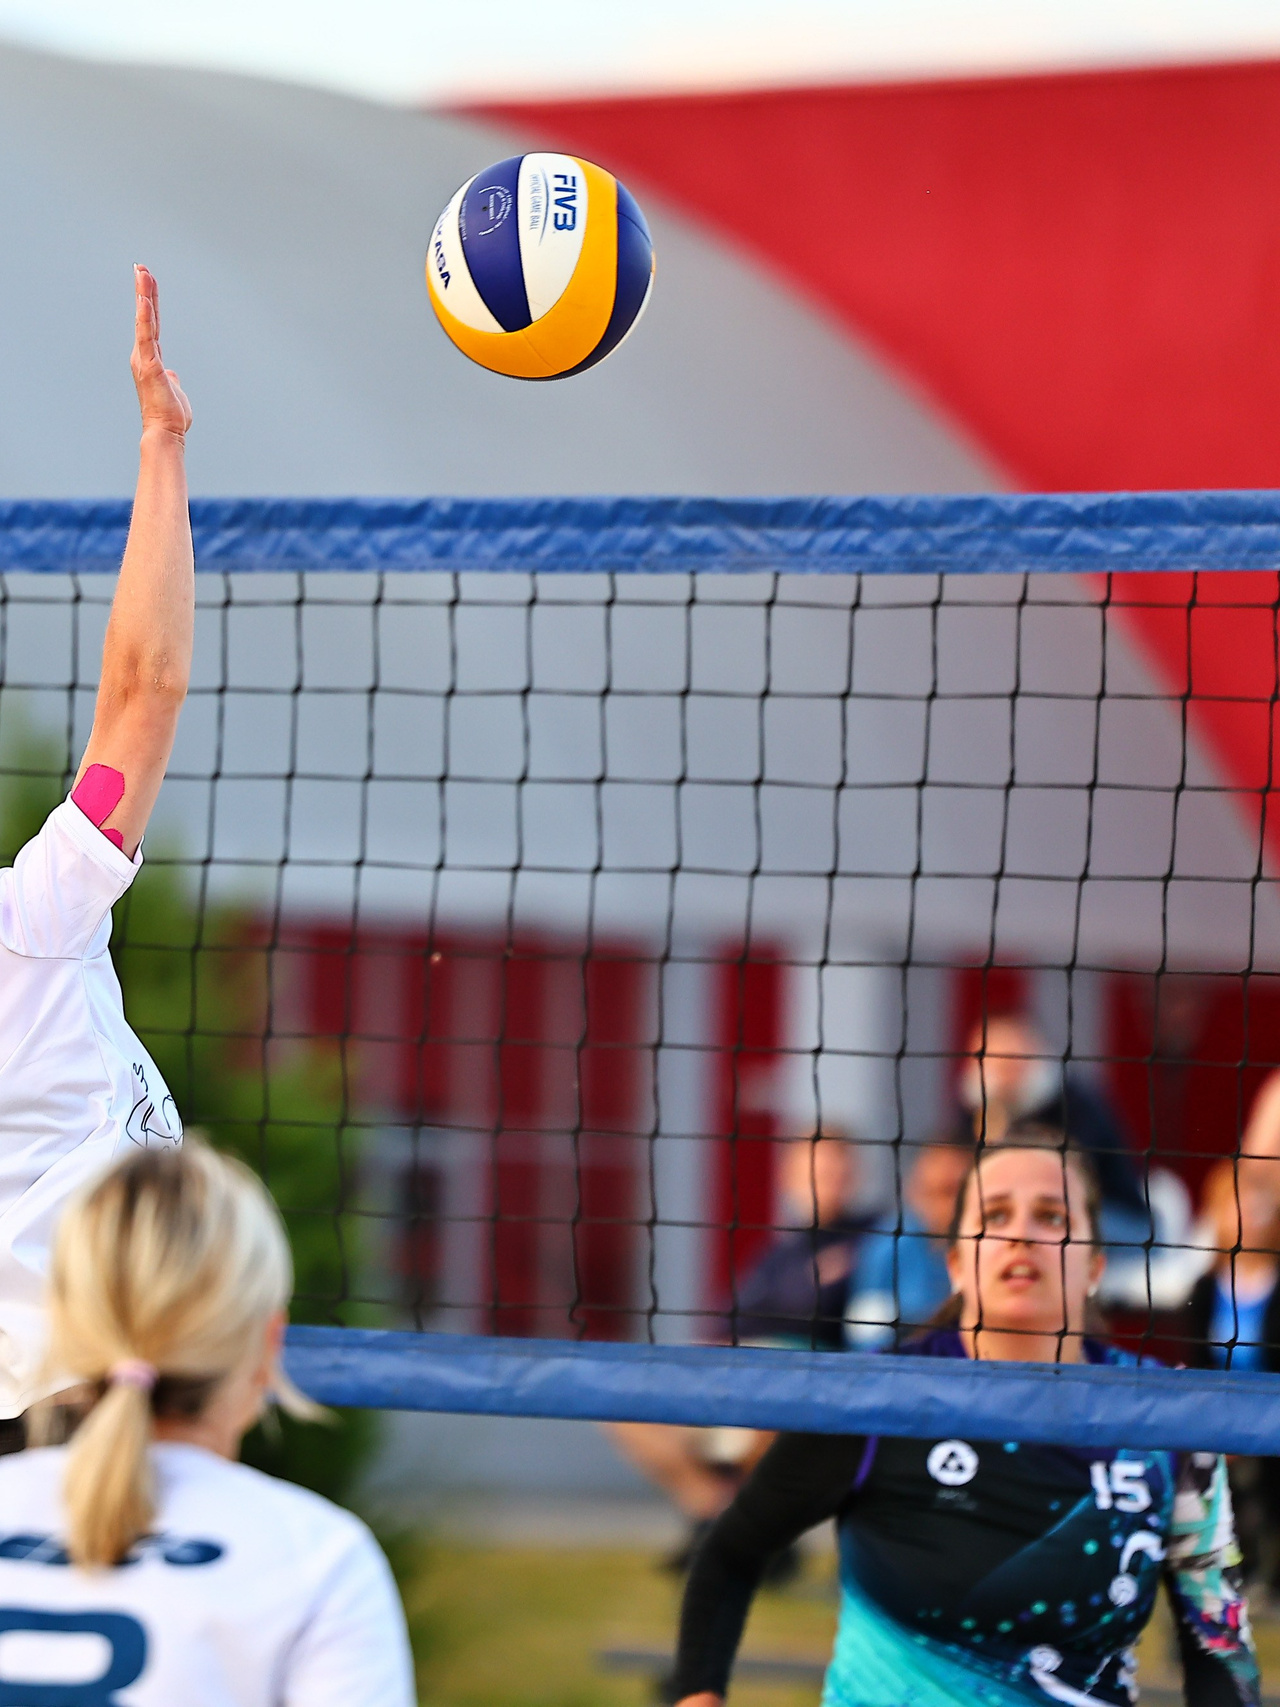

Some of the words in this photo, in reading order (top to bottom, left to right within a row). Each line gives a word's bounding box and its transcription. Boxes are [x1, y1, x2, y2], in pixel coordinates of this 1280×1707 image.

[530, 195, 542, 213] GAME
[553, 174, 577, 231] FIVB
[529, 215, 541, 231] BALL
[1090, 1460, 1152, 1513] 15
